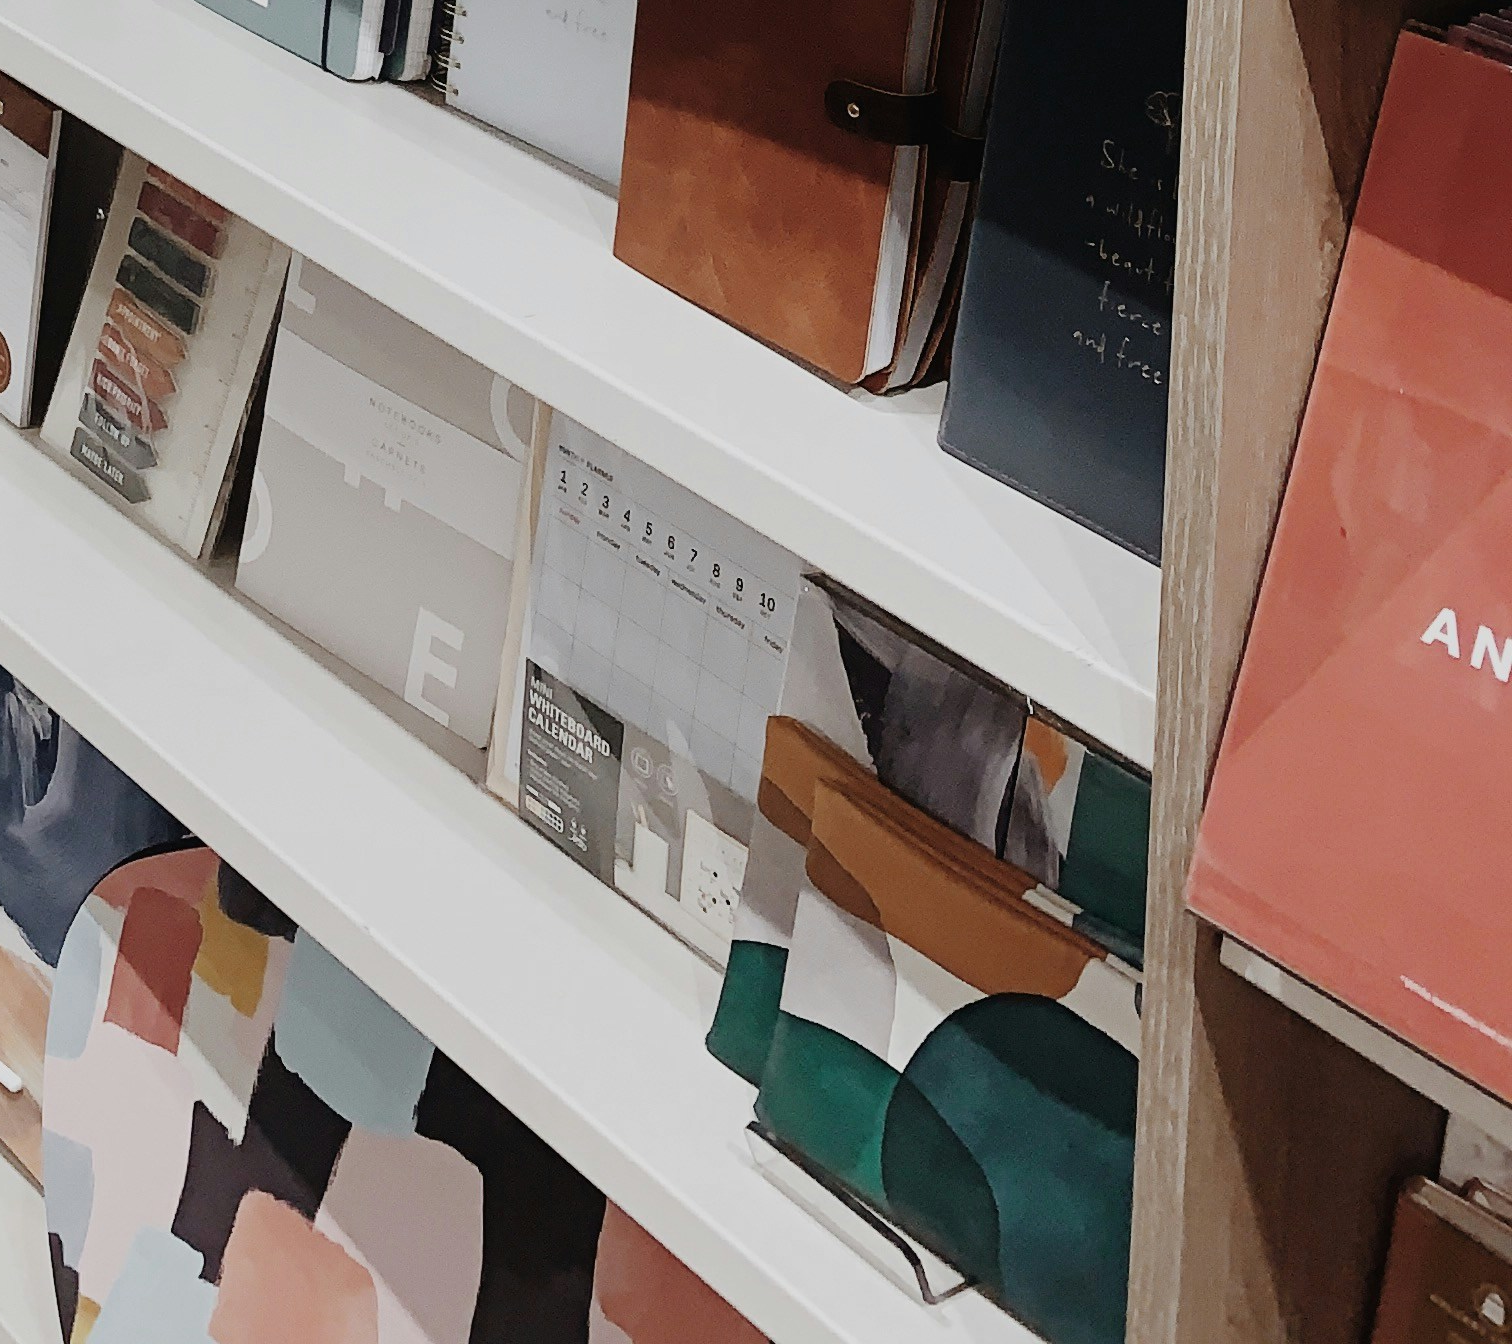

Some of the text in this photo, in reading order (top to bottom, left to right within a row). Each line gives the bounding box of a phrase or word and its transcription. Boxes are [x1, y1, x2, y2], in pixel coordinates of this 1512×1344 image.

[1101, 139, 1139, 180] She
[1073, 330, 1163, 385] and free
[94, 412, 131, 448] FOLLOW UP
[369, 397, 441, 445] NOTEBOOKS
[81, 443, 125, 486] MAYBE LATER
[372, 438, 425, 474] CARNETS
[560, 470, 567, 484] 1
[581, 482, 589, 496] 2
[601, 495, 610, 509] 3
[623, 509, 631, 523] 4
[645, 522, 653, 536] 5
[667, 535, 675, 550] 6
[690, 548, 698, 563] 7
[712, 563, 720, 578] 8
[735, 577, 744, 592] 9
[759, 592, 775, 612] 10
[404, 607, 465, 728] E
[531, 676, 553, 699] MINI
[528, 707, 593, 764] CALENDAR
[529, 689, 610, 758] WHITEBOARD
